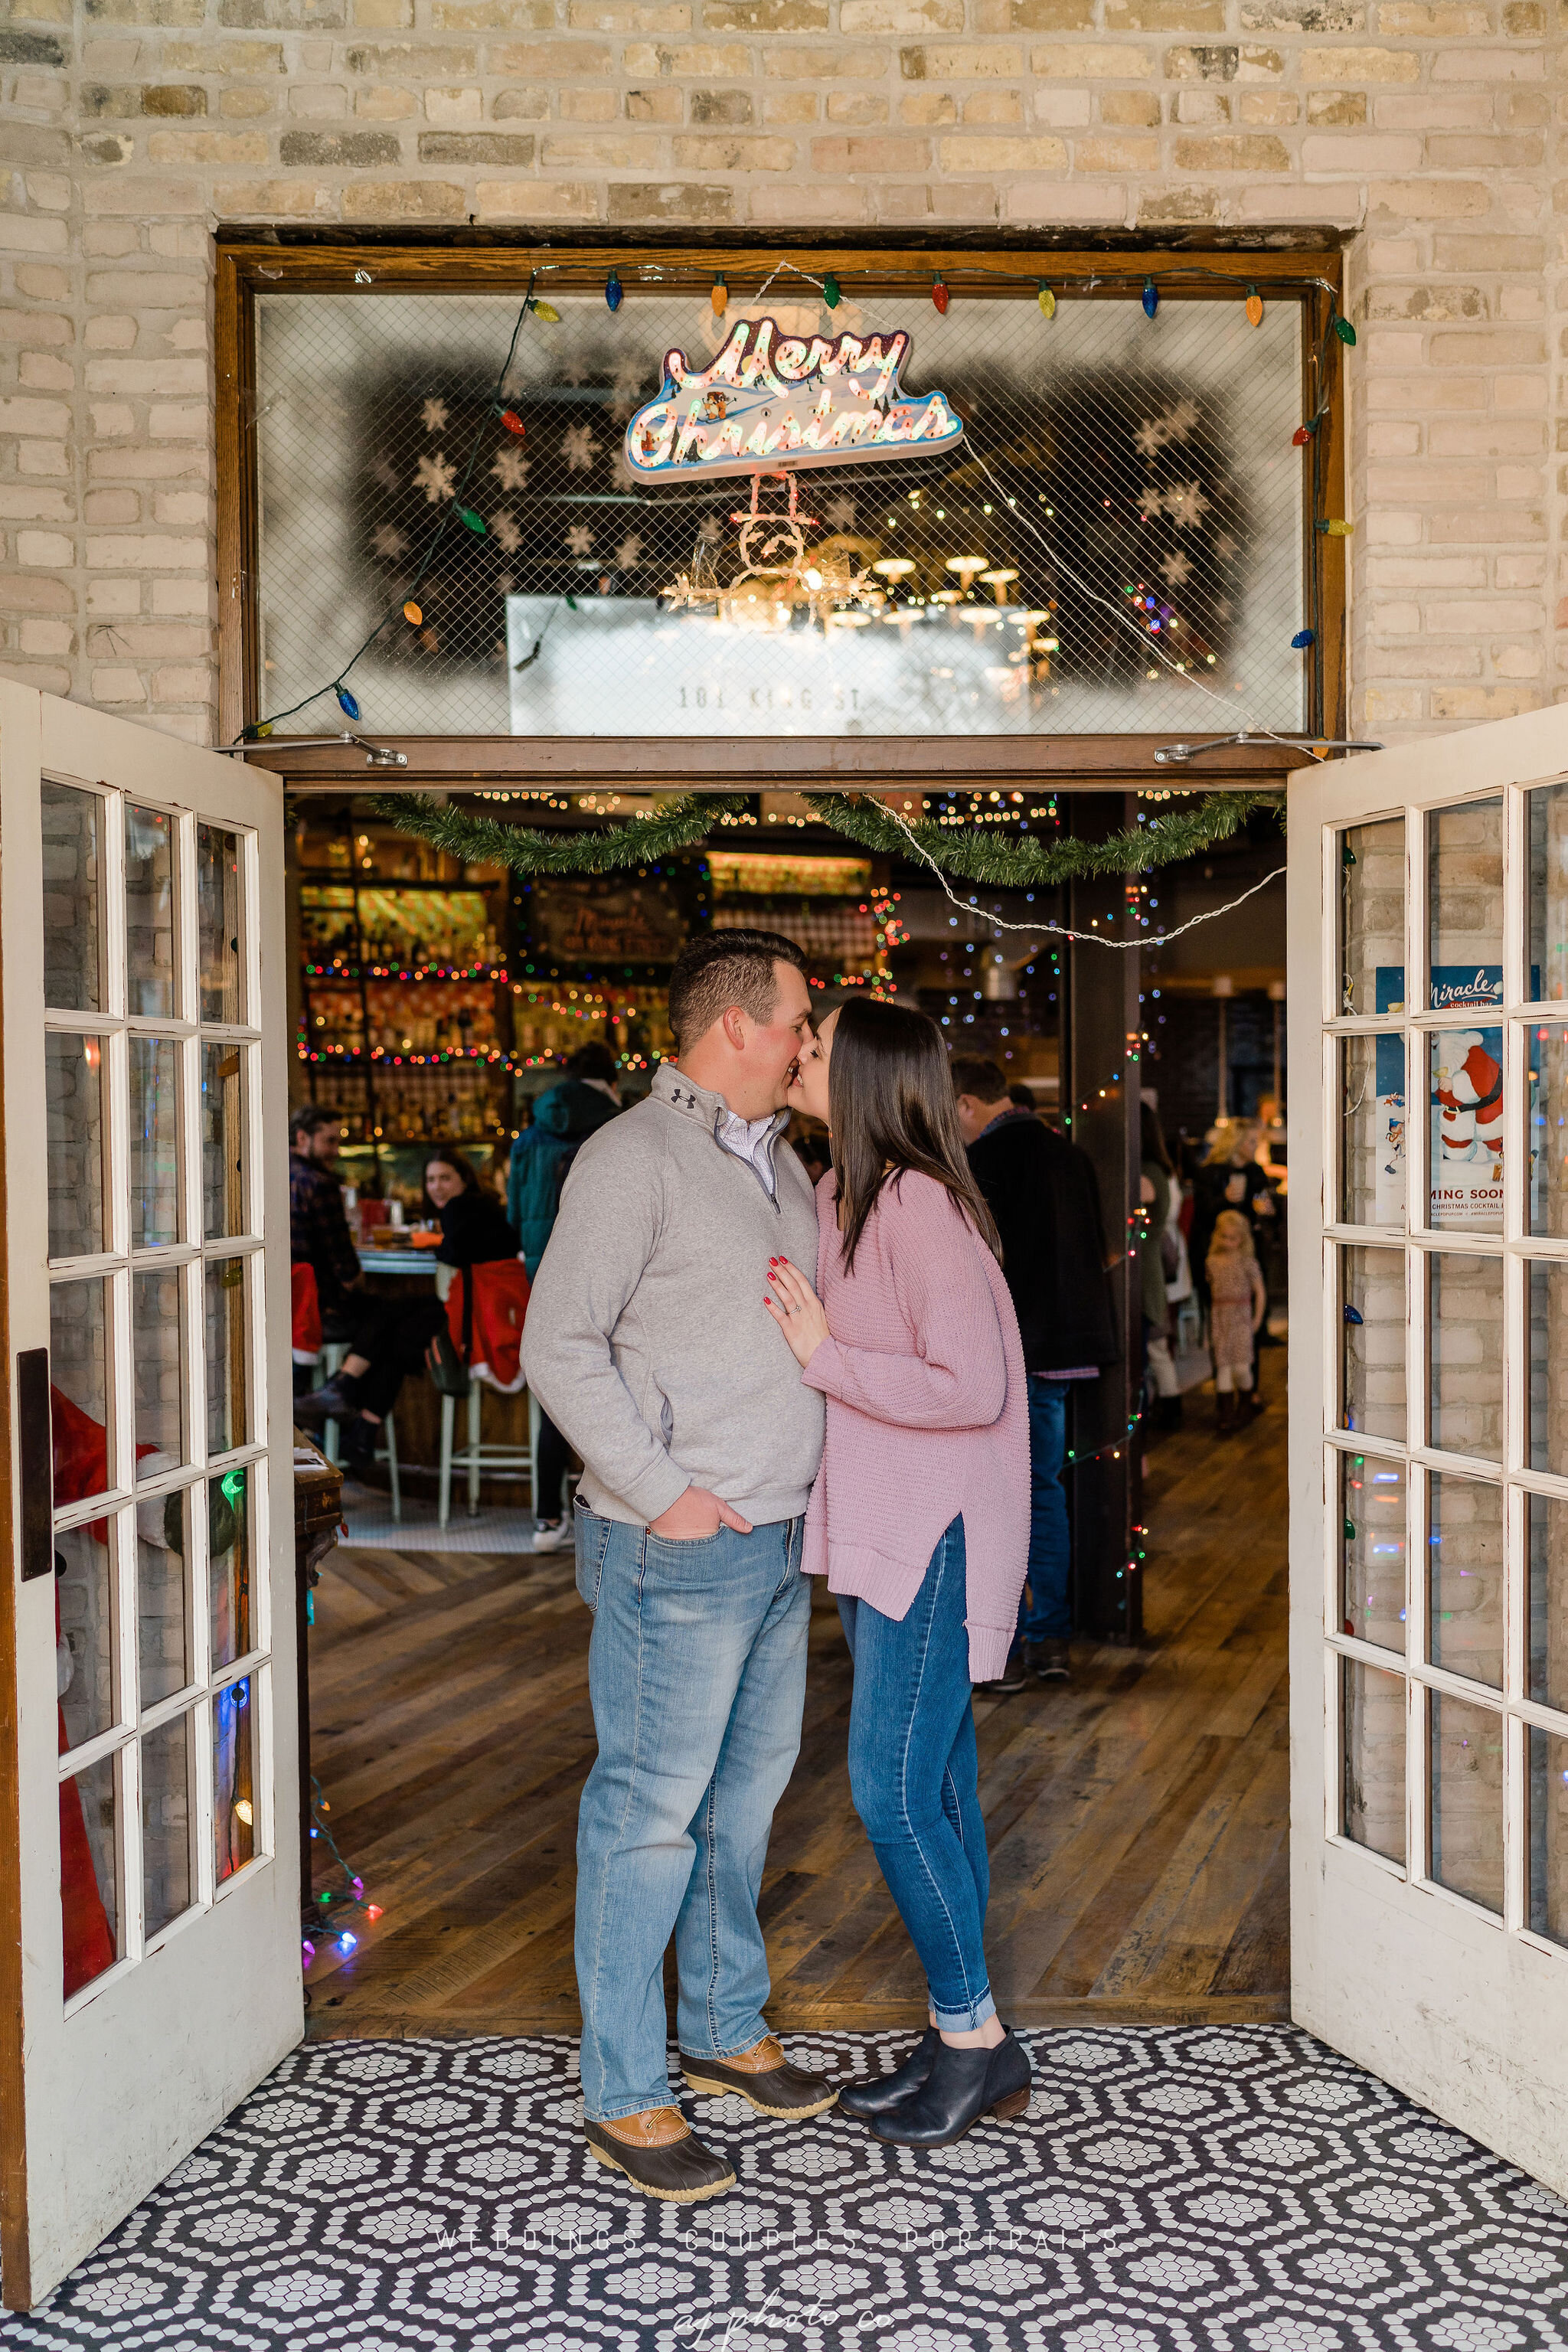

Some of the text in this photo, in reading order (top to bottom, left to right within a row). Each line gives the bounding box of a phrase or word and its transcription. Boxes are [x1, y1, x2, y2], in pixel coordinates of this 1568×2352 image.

[668, 319, 906, 400] Merry
[630, 388, 959, 468] Christmas
[749, 687, 812, 710] KIG
